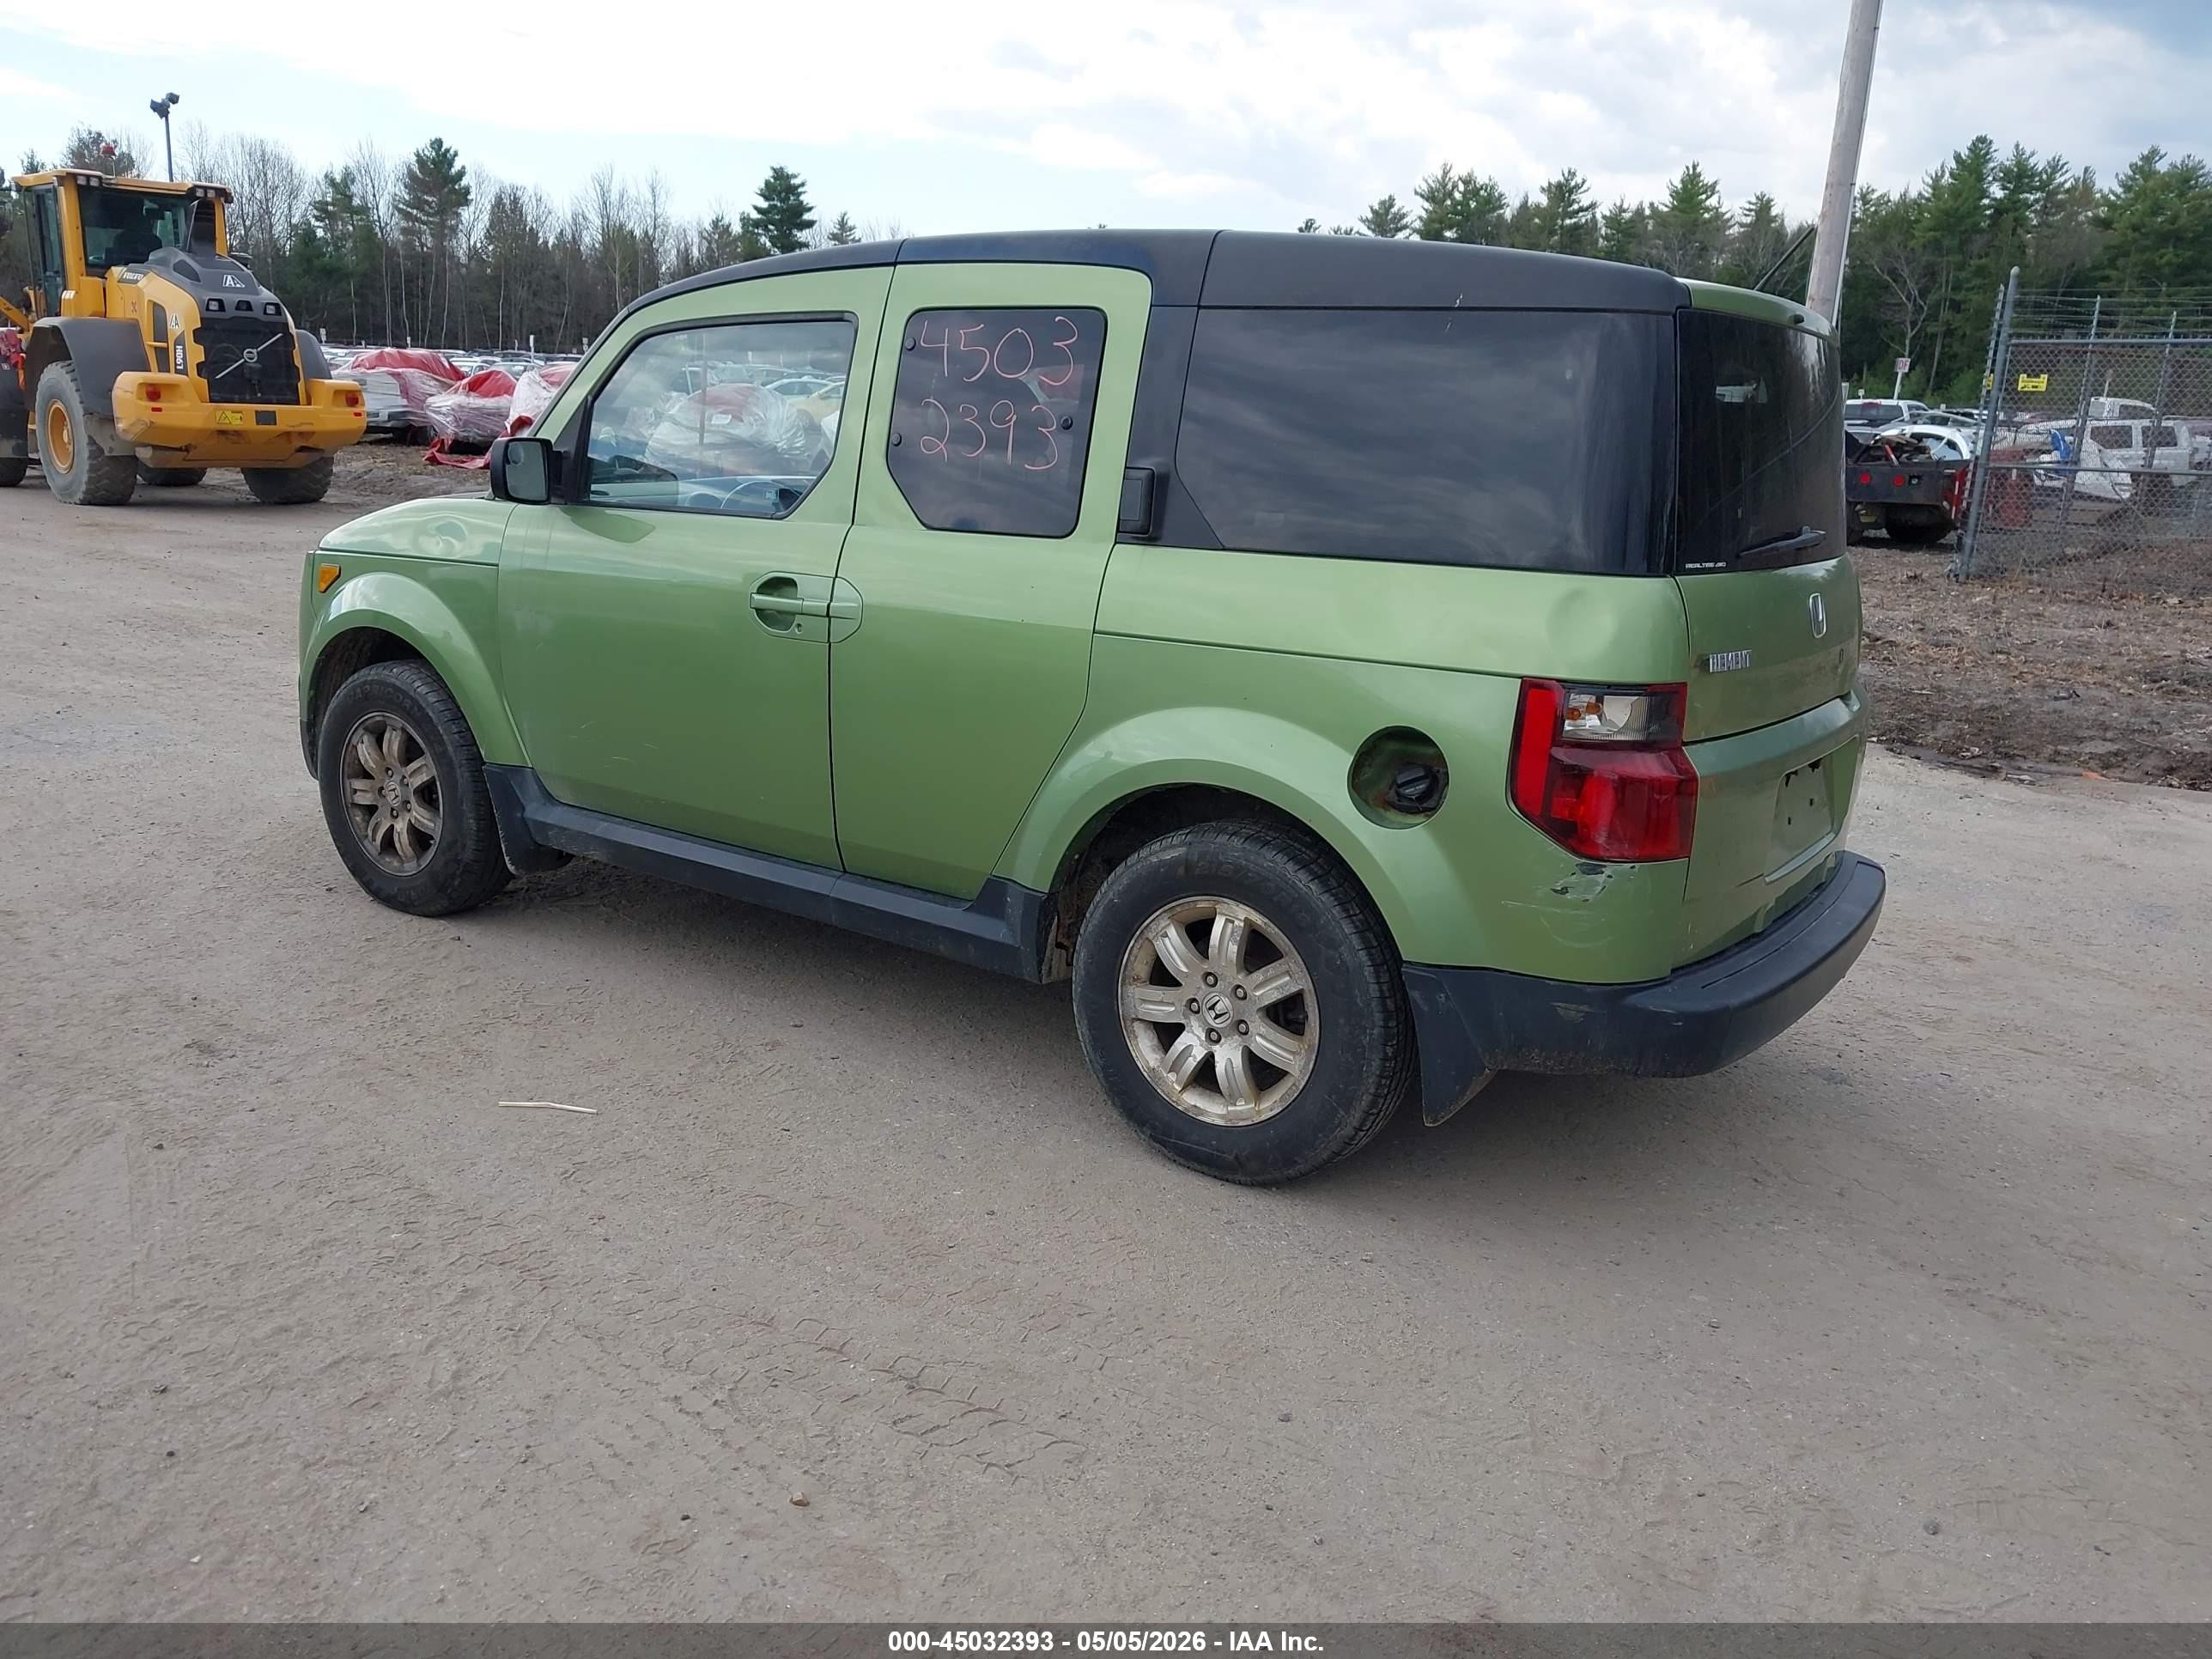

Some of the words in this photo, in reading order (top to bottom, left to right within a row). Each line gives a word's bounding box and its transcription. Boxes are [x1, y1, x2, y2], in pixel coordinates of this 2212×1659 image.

[175, 345, 184, 370] L90H
[920, 316, 1079, 386] 4503
[920, 398, 1058, 471] 2393
